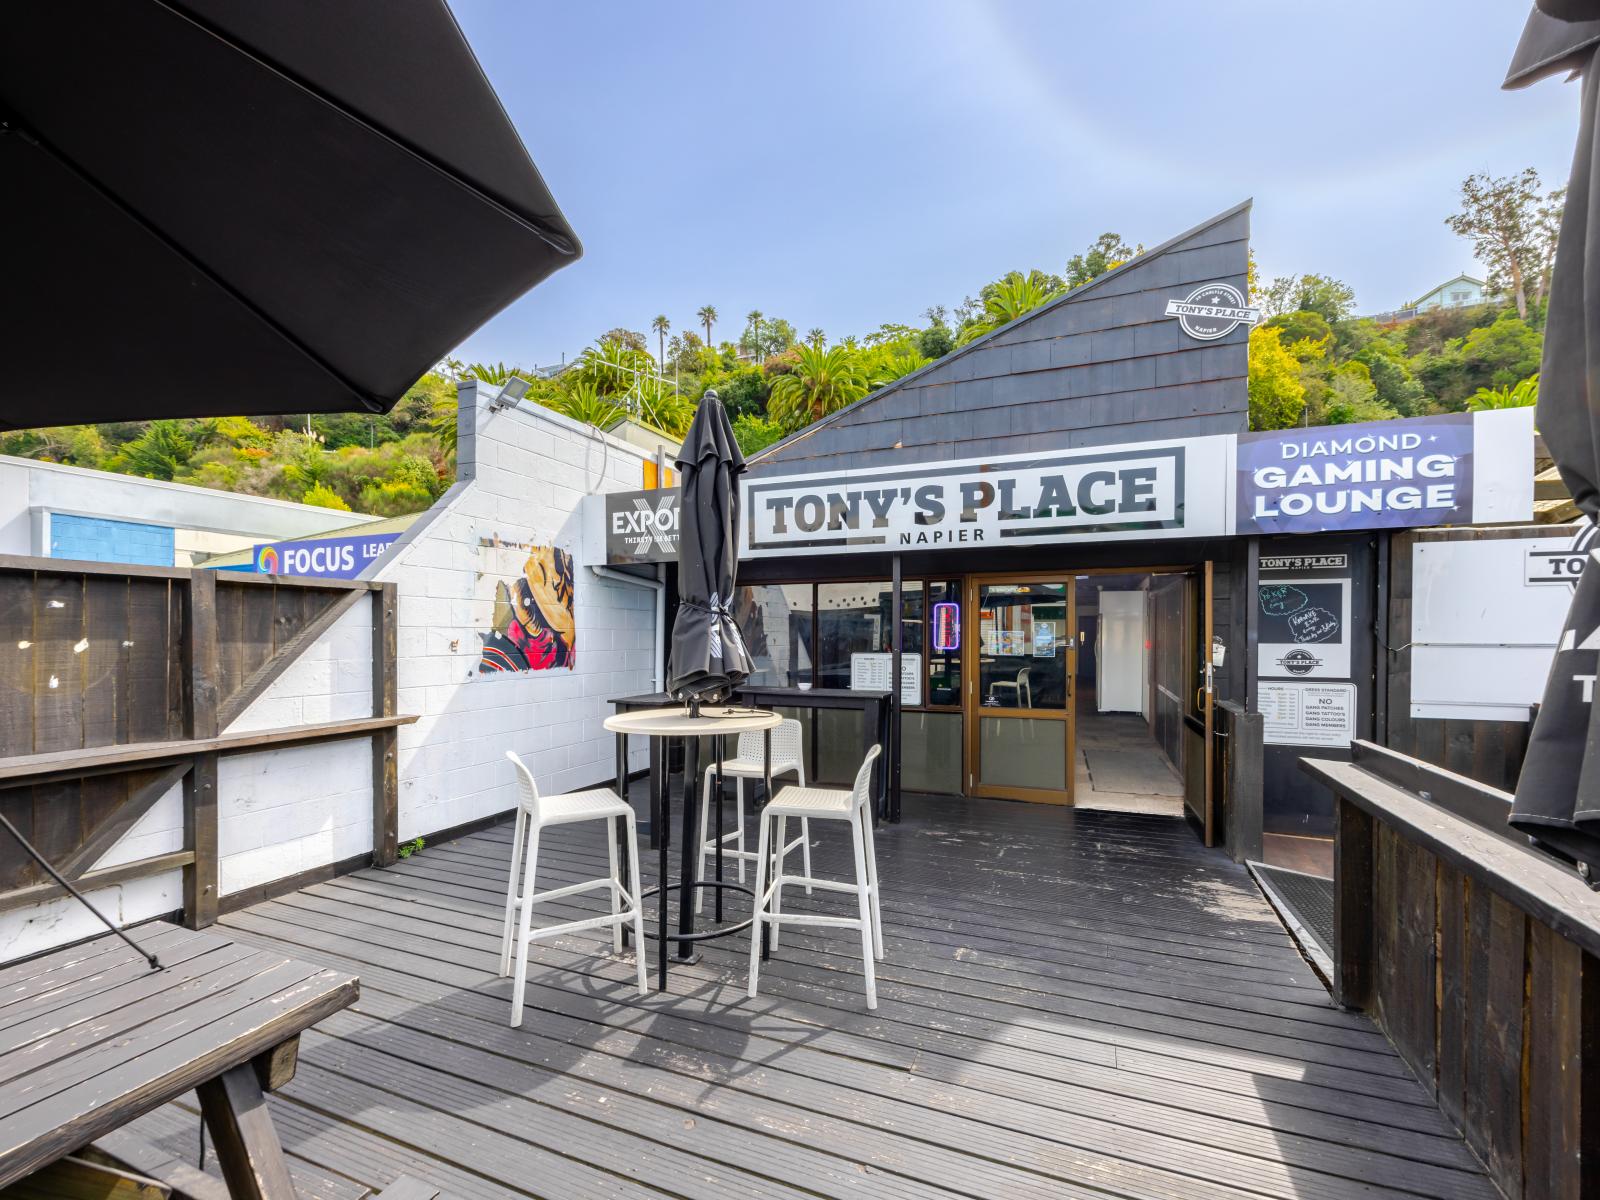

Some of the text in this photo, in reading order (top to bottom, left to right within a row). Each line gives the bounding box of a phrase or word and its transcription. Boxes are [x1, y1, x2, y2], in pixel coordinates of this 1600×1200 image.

[1175, 304, 1251, 319] TONY'S PLACE
[1281, 433, 1421, 459] DIAMOND
[1253, 454, 1455, 489] GAMING
[766, 467, 1157, 534] TONY'S PLACE
[1255, 483, 1455, 518] LOUNGE
[900, 529, 984, 545] NAPIER
[283, 545, 355, 574] FOCUS
[1260, 557, 1343, 568] TONY'S PLACE
